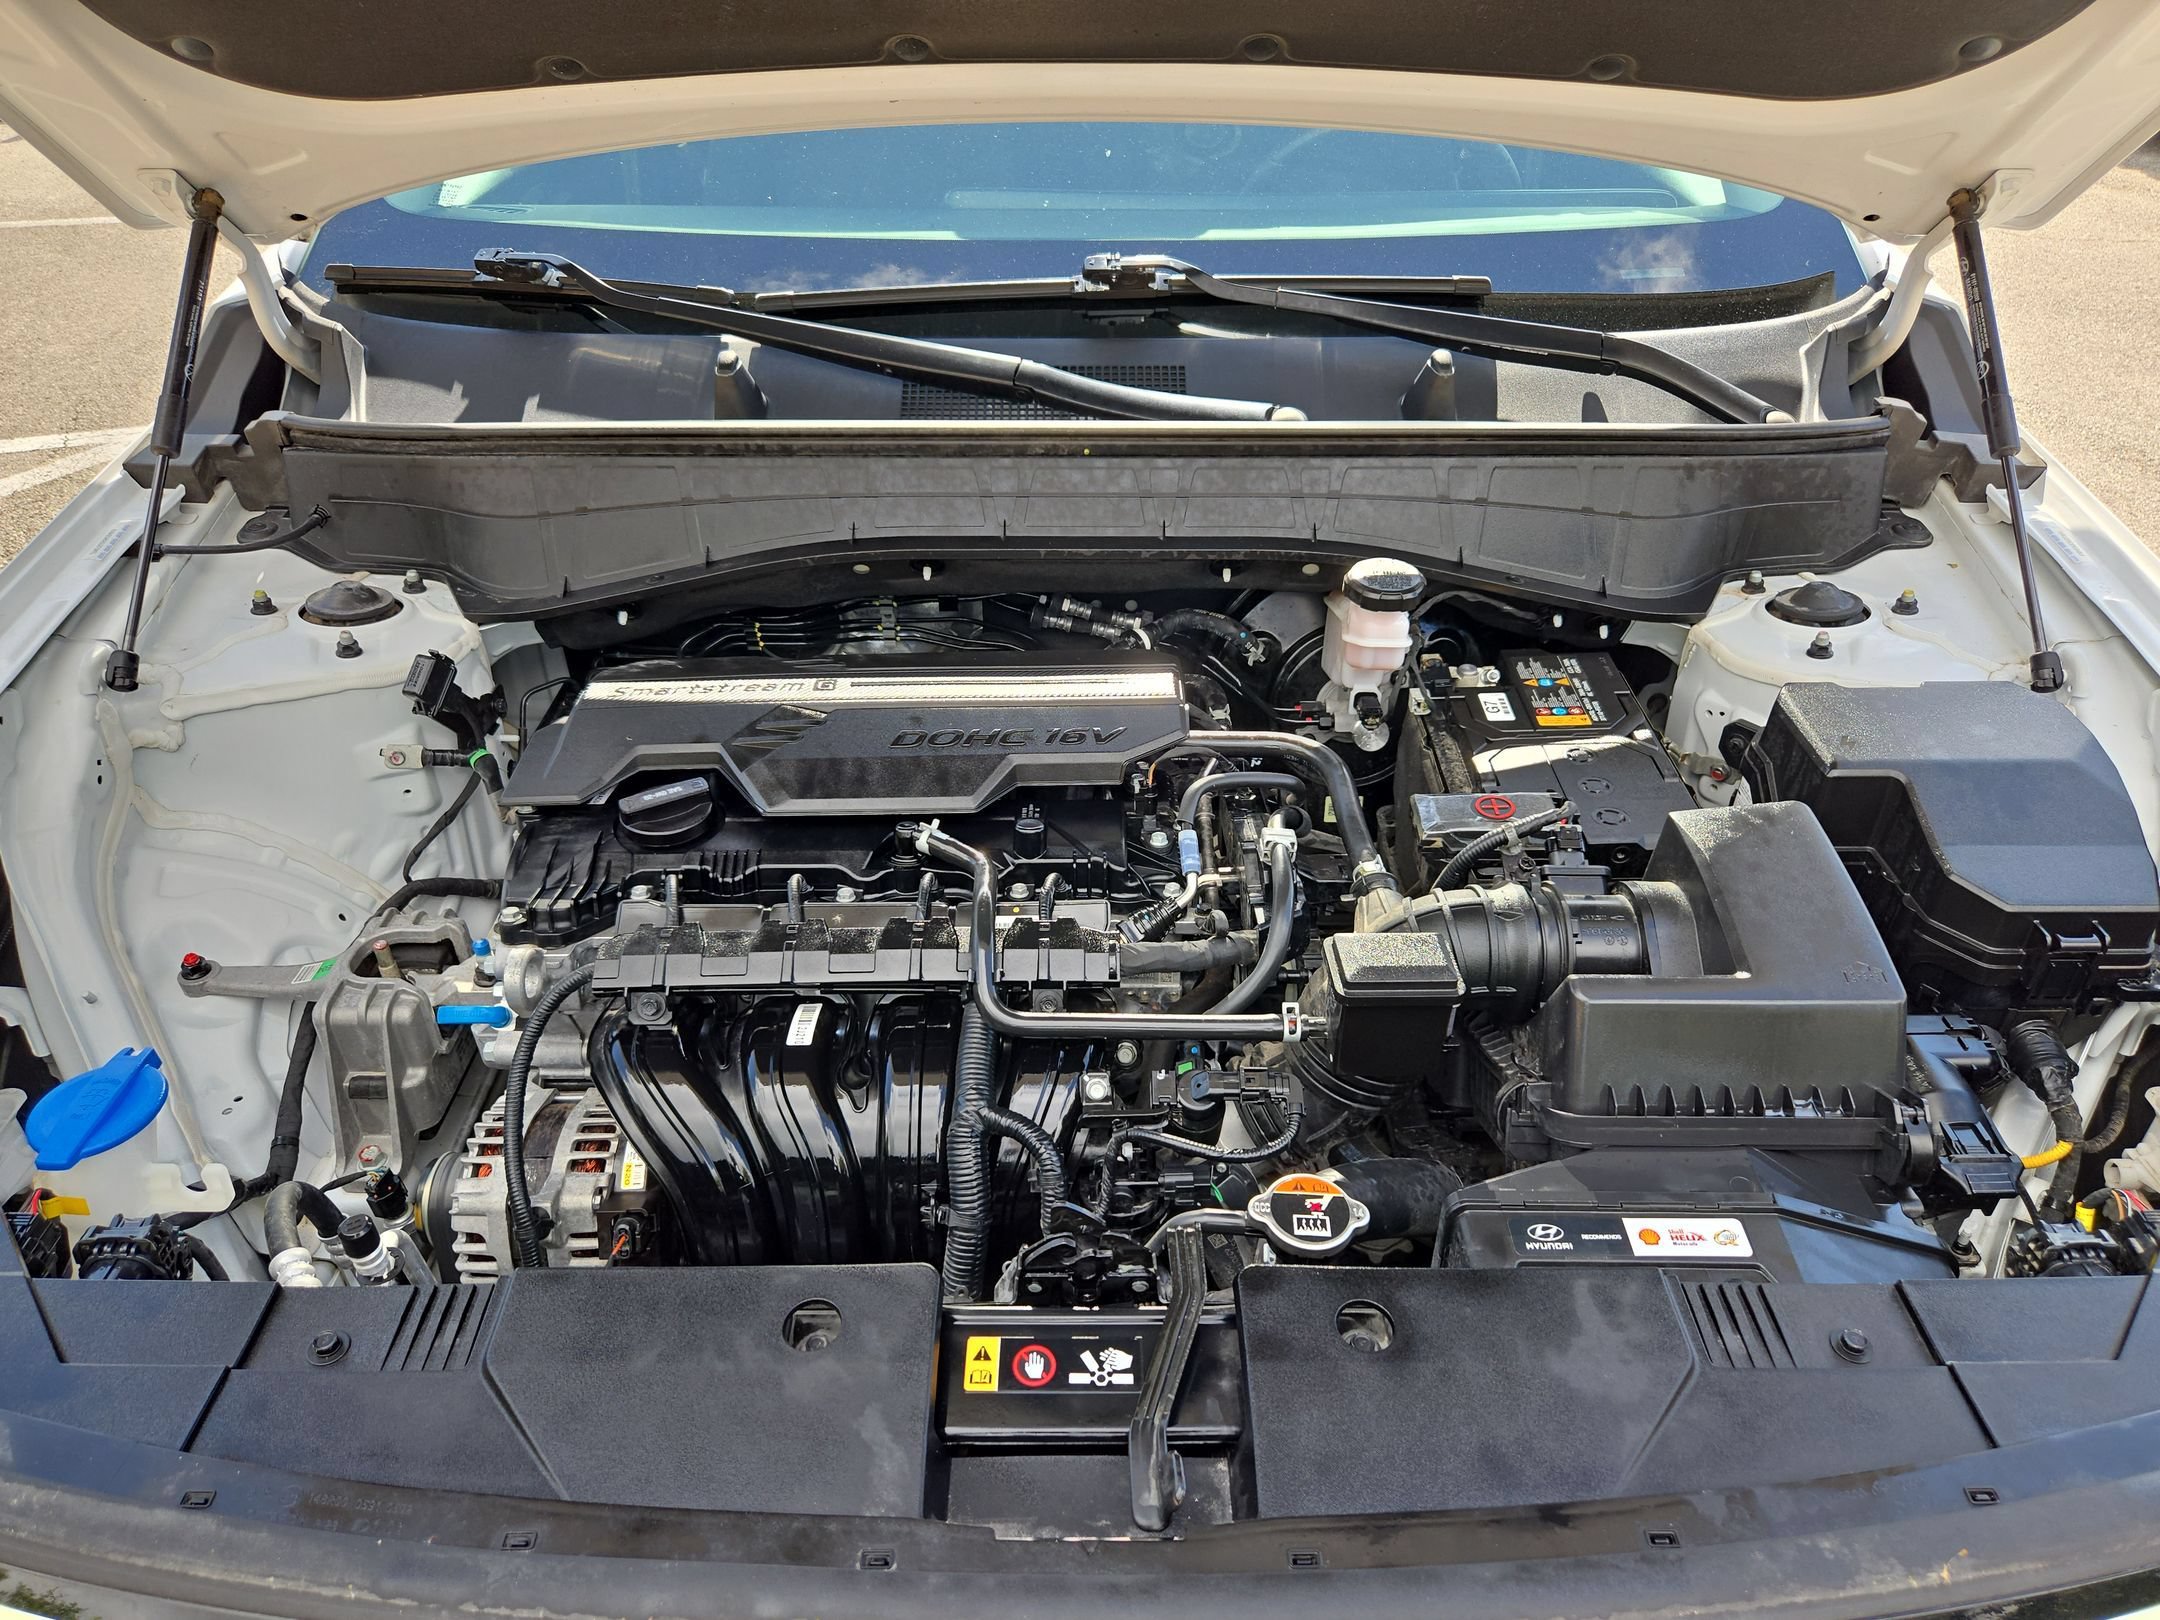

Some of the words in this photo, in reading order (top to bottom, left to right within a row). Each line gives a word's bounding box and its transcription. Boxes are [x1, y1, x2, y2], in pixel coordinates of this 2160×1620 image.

[607, 681, 804, 698] Smartstream
[1484, 701, 1500, 713] G7
[888, 727, 1034, 748] DOHC
[1045, 726, 1128, 746] 16V
[1670, 1233, 1706, 1241] HELIX
[1525, 1241, 1574, 1251] HYUNDAI
